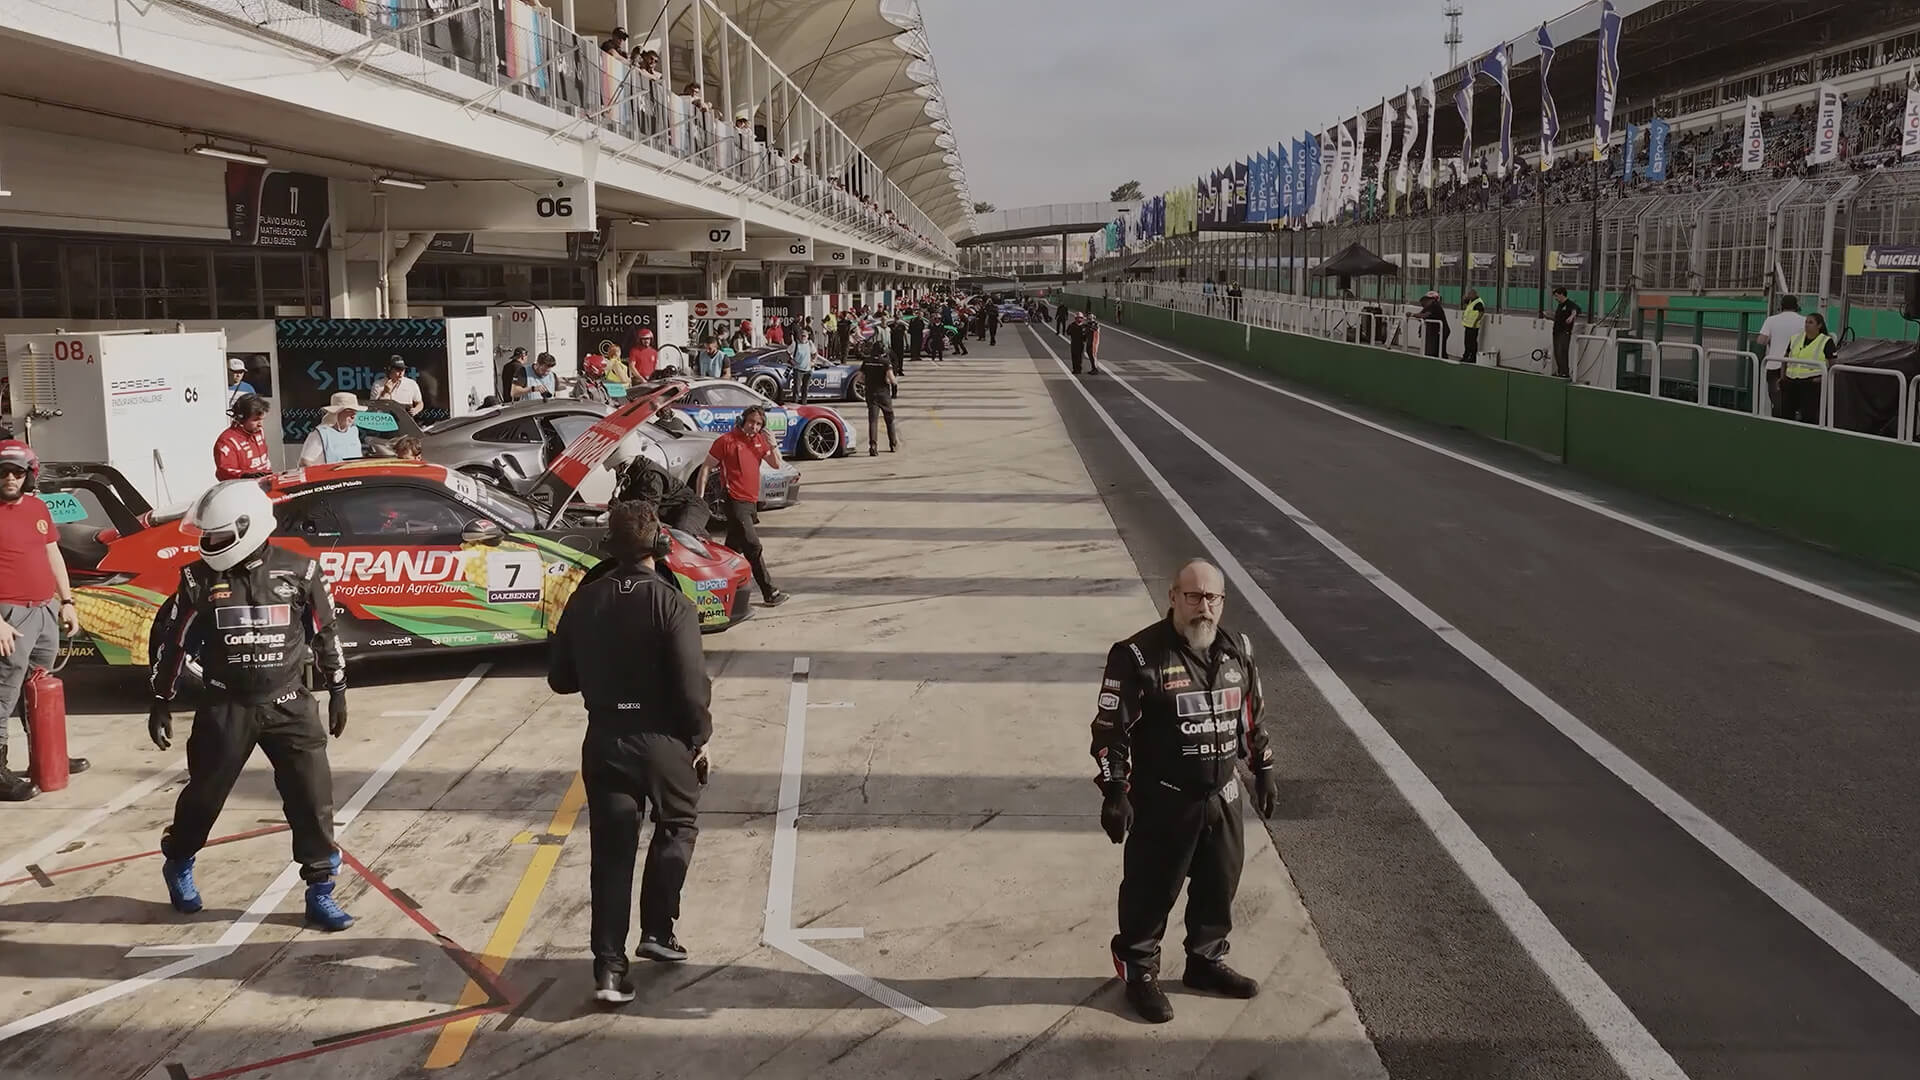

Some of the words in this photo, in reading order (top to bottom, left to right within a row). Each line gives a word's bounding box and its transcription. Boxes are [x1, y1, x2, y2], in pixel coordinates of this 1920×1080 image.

[1820, 110, 1834, 155] Mobil
[1748, 122, 1761, 163] Mobil
[537, 198, 573, 217] 06
[709, 229, 731, 242] 07
[789, 244, 807, 255] 08
[831, 252, 846, 260] 09
[859, 257, 870, 265] 10
[511, 311, 528, 322] 09
[580, 312, 650, 328] galaticos
[54, 340, 84, 361] 08
[86, 354, 94, 364] A
[184, 387, 199, 403] C6
[357, 414, 393, 423] CHROMA
[47, 499, 77, 510] OMA
[319, 550, 470, 583] BRANDT
[504, 564, 521, 588] 7
[335, 583, 404, 597] Professional
[406, 582, 468, 595] Agriculture
[490, 591, 538, 601] OAKBERRY
[224, 632, 286, 646] Confidence
[376, 636, 413, 647] quartzolit
[242, 652, 284, 663] BLUE3
